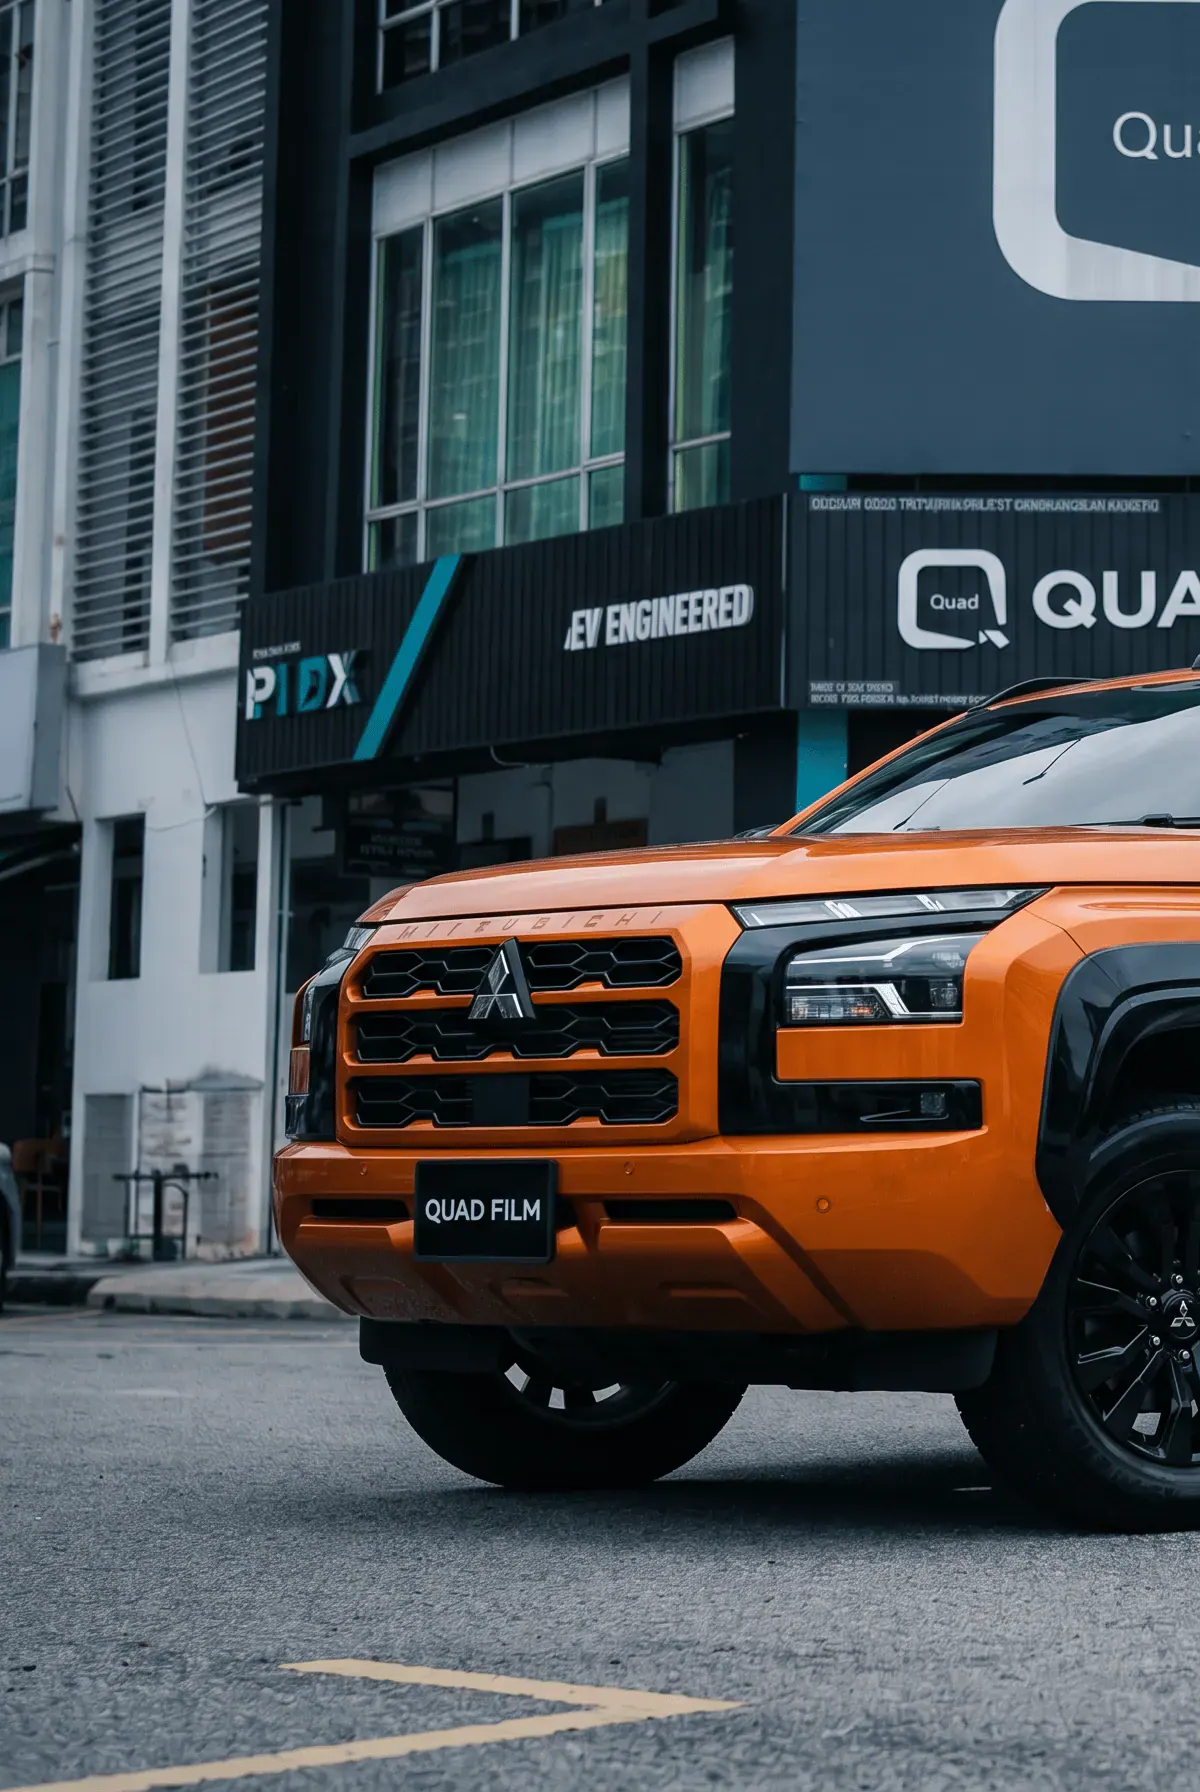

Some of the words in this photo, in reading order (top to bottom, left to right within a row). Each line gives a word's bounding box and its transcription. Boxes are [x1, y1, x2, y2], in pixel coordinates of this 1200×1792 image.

[604, 583, 755, 646] ENGINEERED
[929, 593, 980, 612] Quad
[425, 1198, 485, 1224] QUAD
[491, 1198, 541, 1221] FILM
